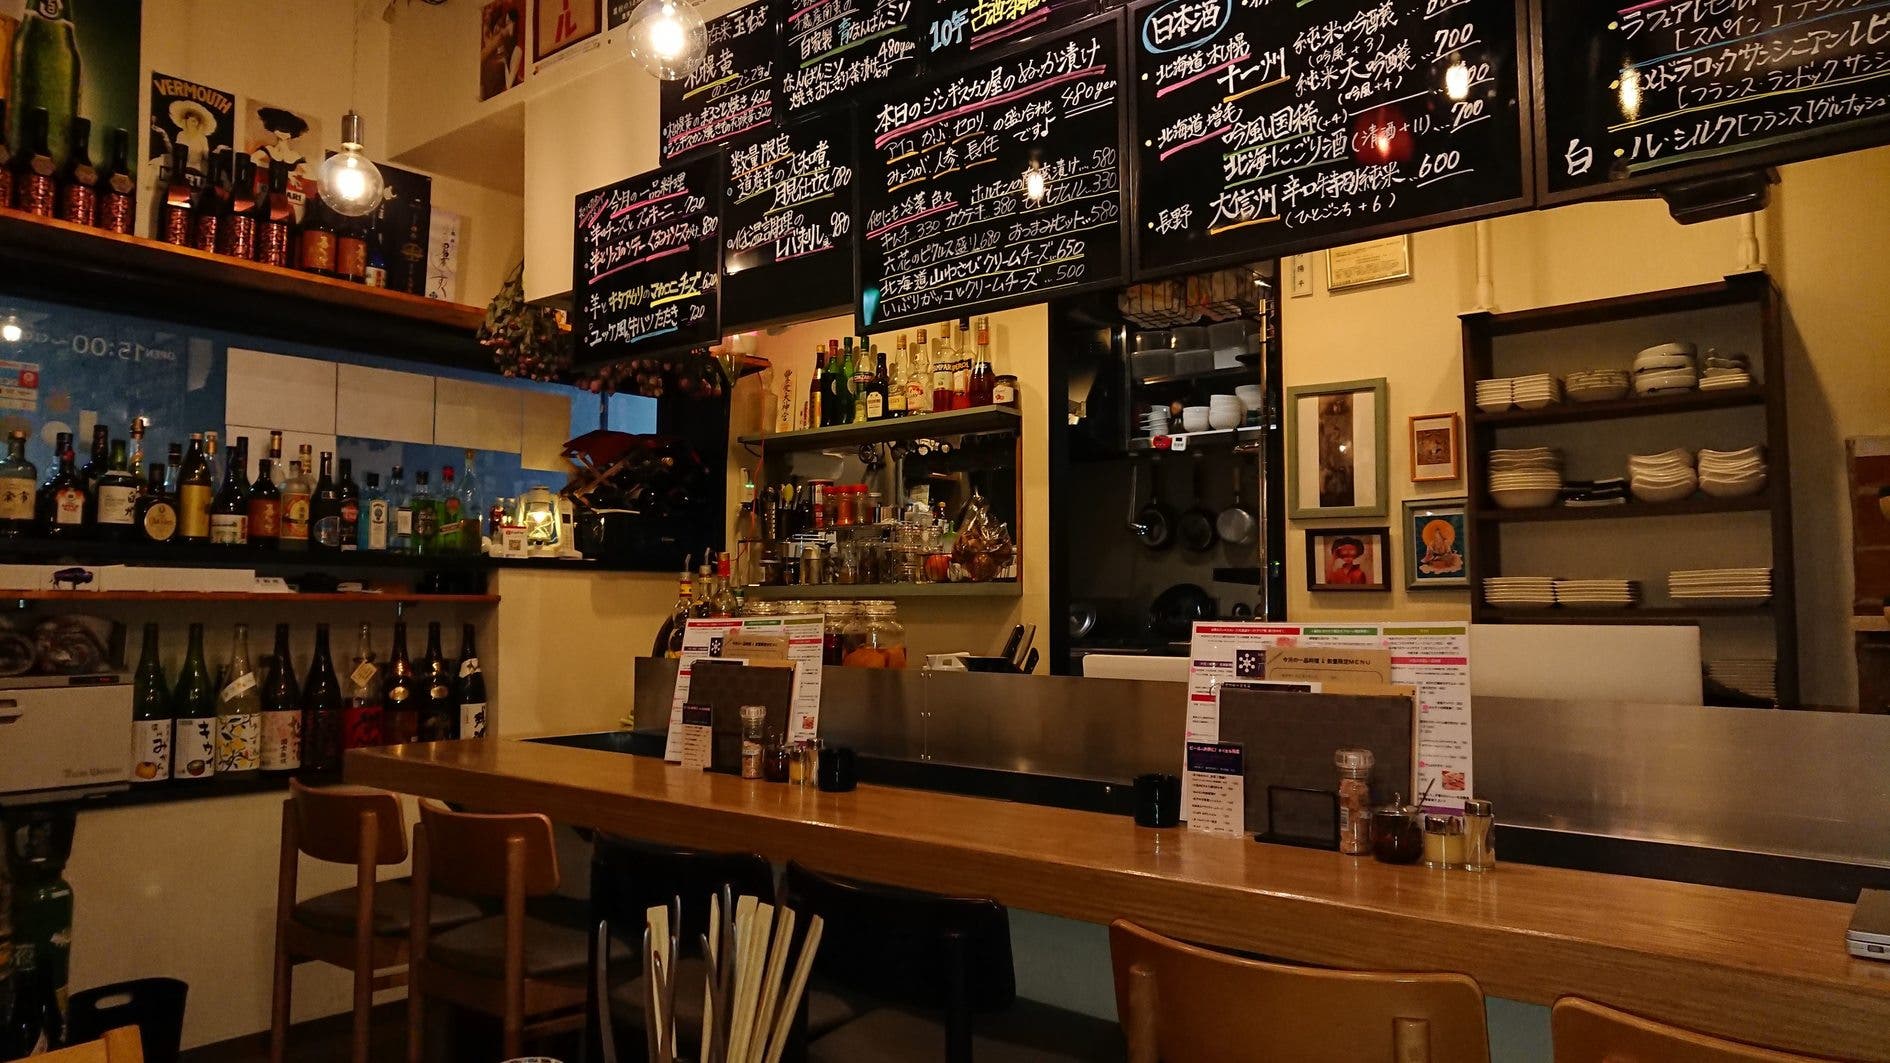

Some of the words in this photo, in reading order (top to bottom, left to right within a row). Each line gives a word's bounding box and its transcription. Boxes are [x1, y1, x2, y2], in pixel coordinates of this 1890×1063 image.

[930, 8, 969, 52] 10年
[1152, 1, 1222, 44] 日本酒
[1435, 24, 1472, 56] 700
[801, 27, 832, 59] 自家製
[878, 38, 916, 62] 480yen
[154, 78, 233, 114] VERMOUTH
[1062, 80, 1117, 108] 480yen
[730, 132, 791, 176] 数量限定
[1223, 128, 1348, 181] 北海にごり酒
[1451, 99, 1483, 128] 700
[1565, 138, 1593, 176] 白
[1091, 148, 1116, 169] 580
[607, 172, 686, 213] 今月の一品料理
[832, 166, 852, 189] 780
[1155, 205, 1193, 235] 長野
[1207, 183, 1277, 229] 大信州
[1419, 150, 1460, 178] 600
[684, 196, 706, 214] 720
[881, 226, 910, 250] キムチ
[917, 220, 940, 239] 330
[946, 205, 984, 228] カクテキ
[993, 198, 1016, 215] 380
[1093, 171, 1117, 192] 330
[732, 210, 804, 250] 低温調理の
[831, 211, 850, 237] 980
[979, 230, 1001, 249] 680
[1090, 200, 1118, 222] 580
[1055, 241, 1085, 260] 650
[1056, 264, 1085, 280] 500
